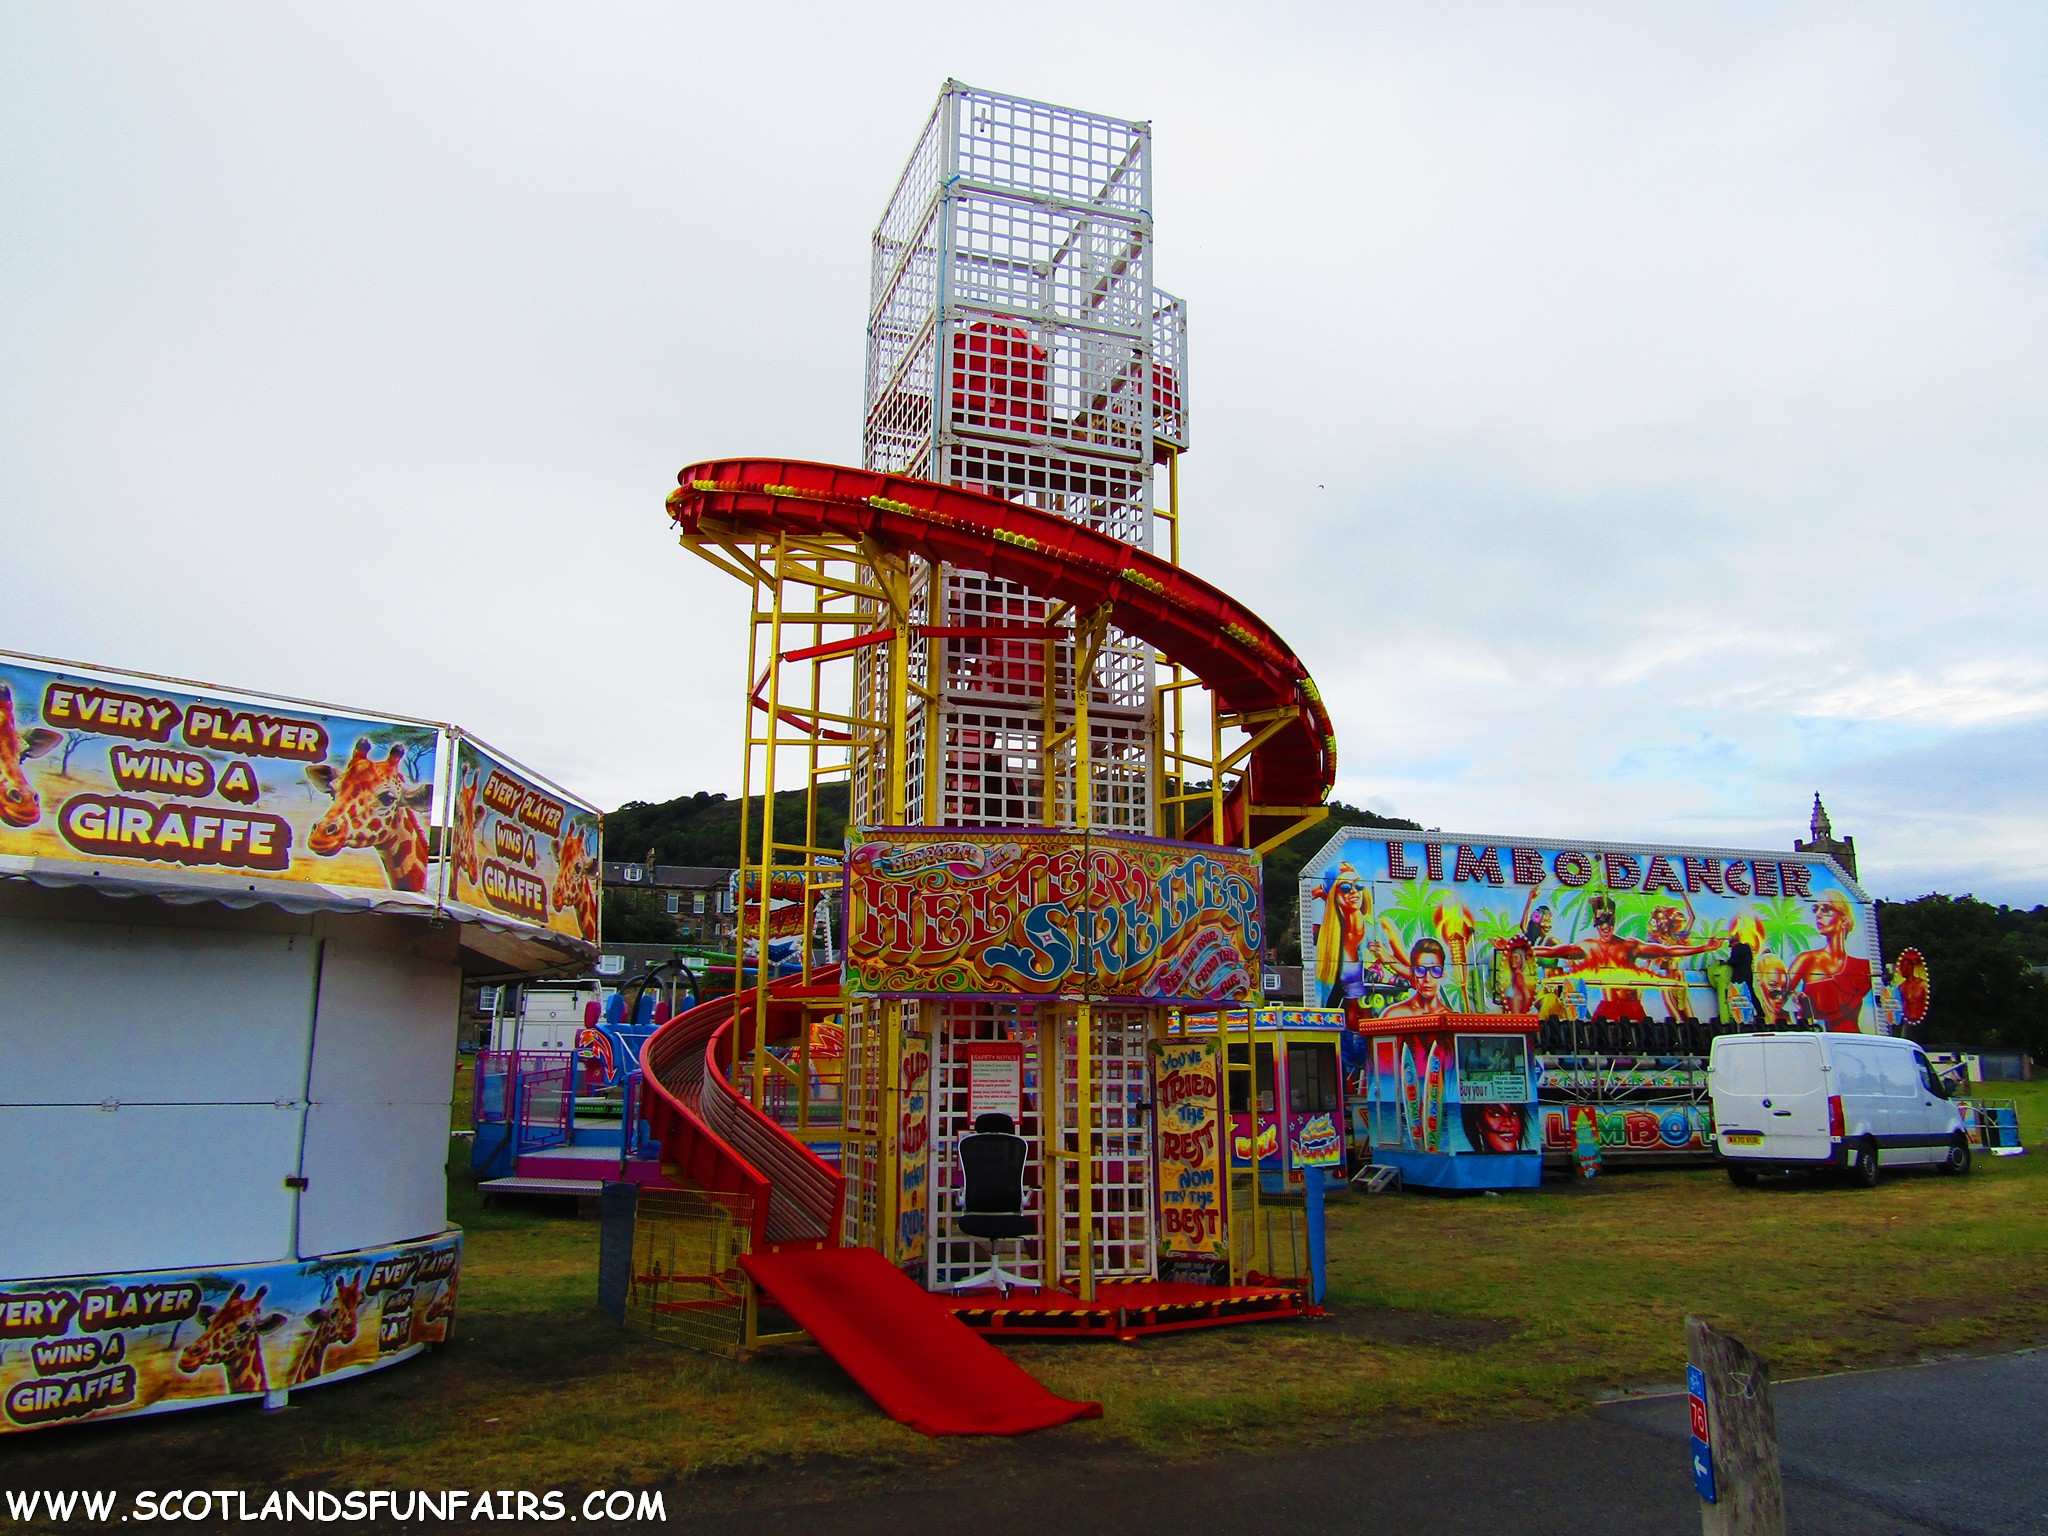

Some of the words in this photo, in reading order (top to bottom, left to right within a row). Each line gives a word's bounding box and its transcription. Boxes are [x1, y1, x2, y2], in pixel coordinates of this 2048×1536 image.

[50, 689, 173, 733] EVERY
[189, 711, 320, 754] PLAYER
[117, 751, 205, 788] WINS
[225, 767, 250, 791] A
[484, 776, 521, 809] EVERY
[520, 796, 562, 830] PLAYER
[68, 803, 278, 856] GIRAFFE
[496, 825, 521, 855] WINS
[525, 839, 534, 859] A
[484, 866, 543, 911] GIRAFFE
[1387, 841, 1592, 887] LIMBO
[1605, 853, 1813, 897] DANCER
[857, 850, 1147, 955] HELTER
[983, 855, 1261, 983] SKELTER
[903, 1052, 929, 1099] SLIP
[1162, 1049, 1203, 1071] YOU'VE
[1158, 1069, 1217, 1109] TRIED
[1177, 1102, 1205, 1126] THE
[1548, 1112, 1691, 1147] LMBO
[1163, 1120, 1215, 1169] REST
[1179, 1168, 1214, 1188] NOW
[1164, 1191, 1186, 1204] TRY
[1188, 1190, 1214, 1209] THE
[901, 1208, 925, 1248] RIDE
[1164, 1208, 1219, 1245] BEST
[85, 1289, 193, 1320] PLAYER
[37, 1342, 96, 1366] WINS
[106, 1338, 119, 1356] A
[13, 1371, 127, 1412] GIRAFFE
[1691, 1402, 1704, 1433] 76
